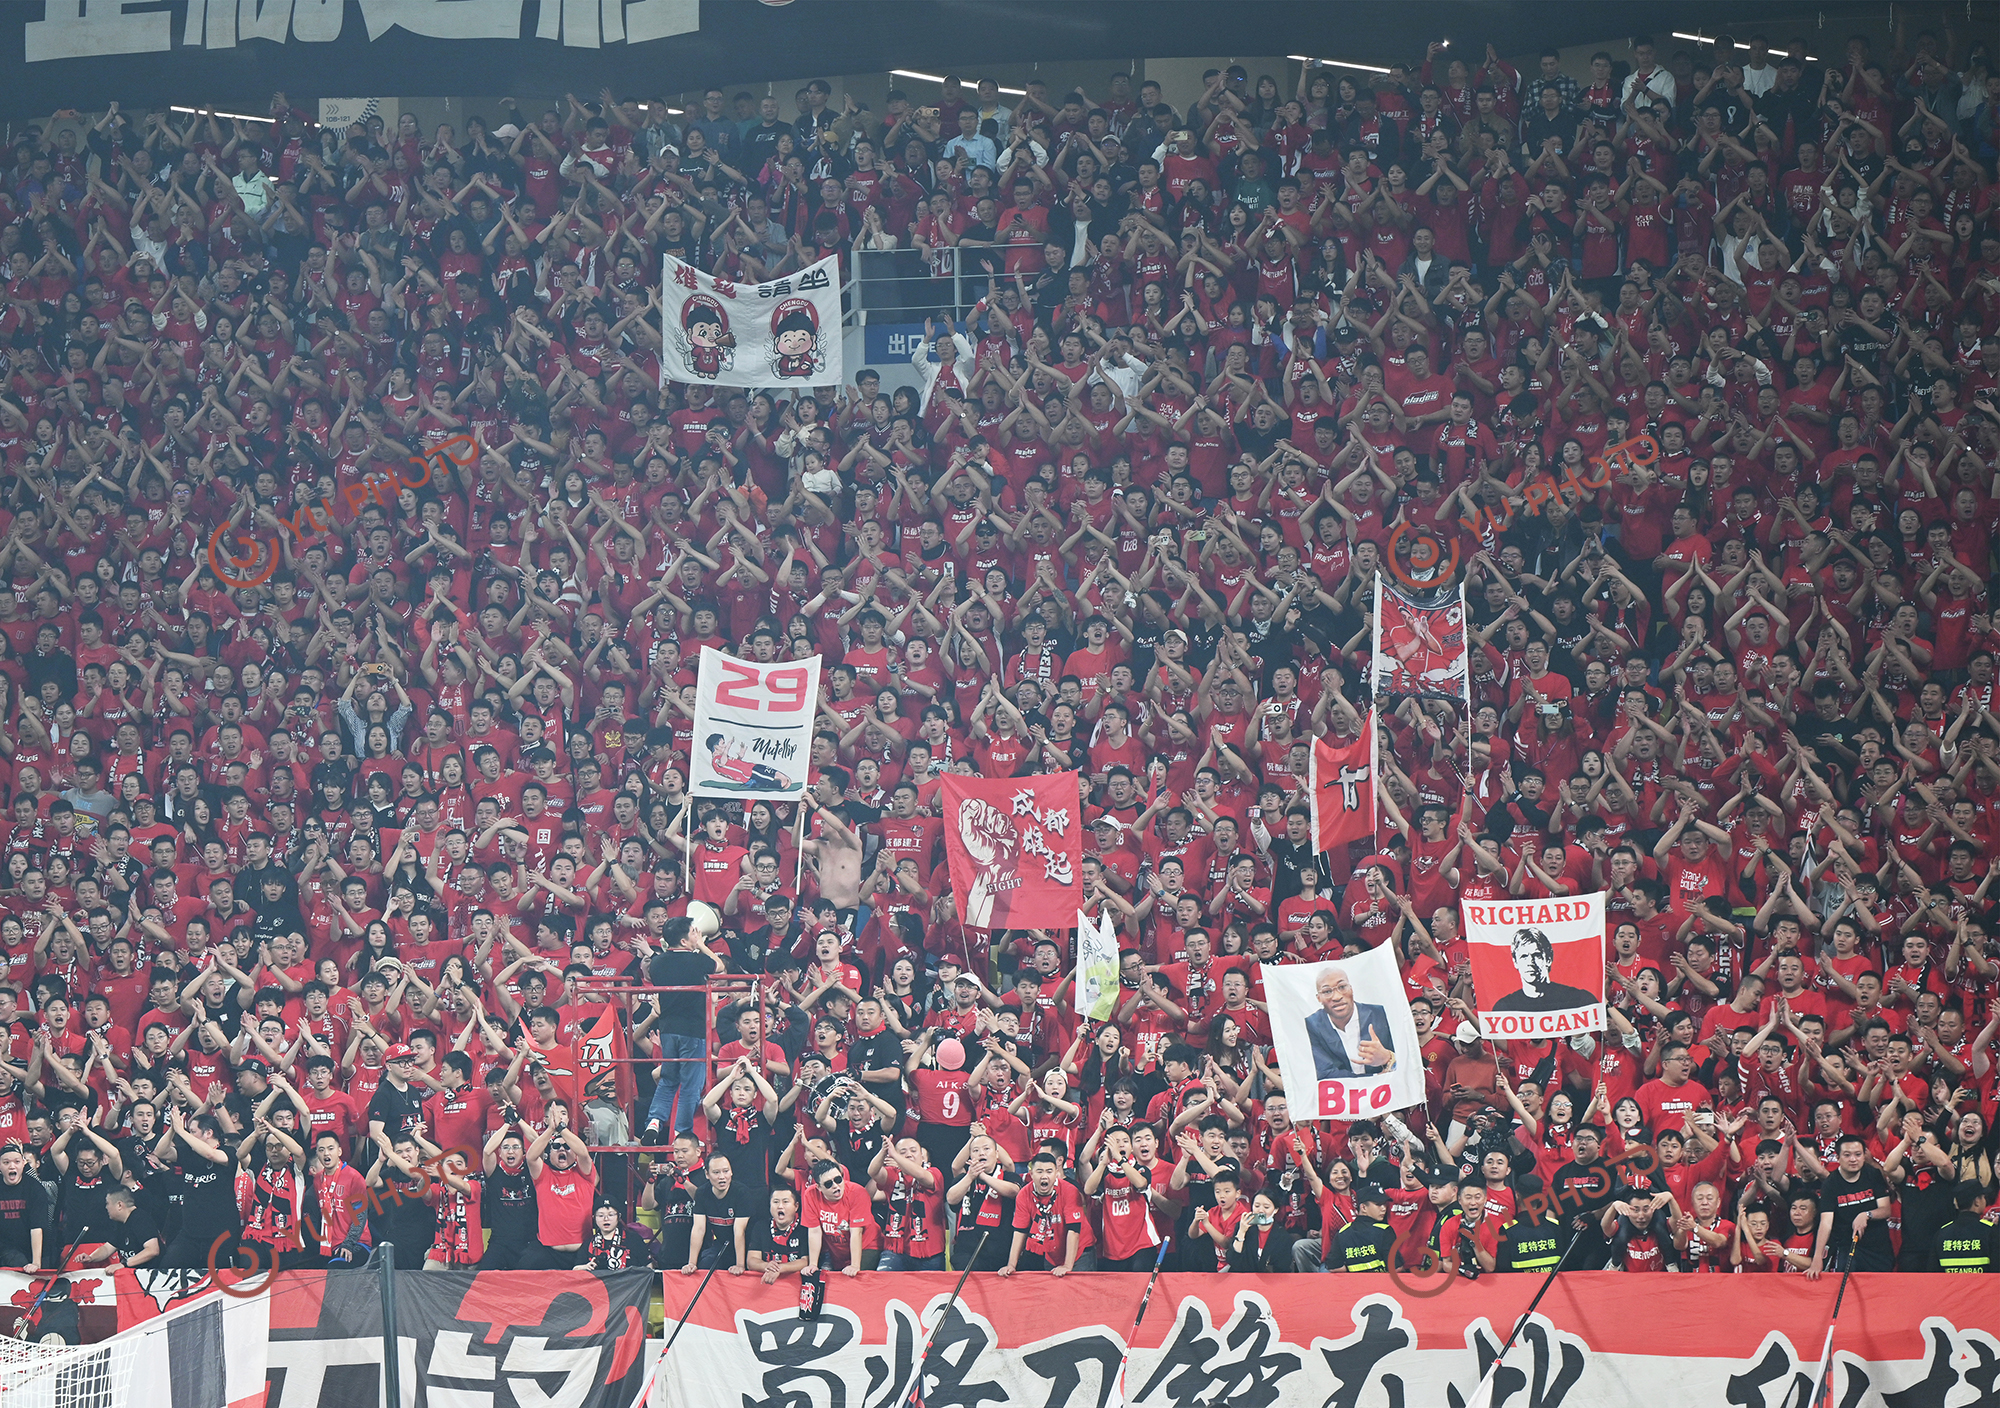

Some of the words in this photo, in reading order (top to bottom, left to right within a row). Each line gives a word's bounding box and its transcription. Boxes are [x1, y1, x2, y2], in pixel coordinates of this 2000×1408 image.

[779, 300, 809, 311] CHENGDU
[888, 333, 924, 355] 出口
[715, 660, 808, 712] 29
[752, 738, 797, 760] Mutellip
[987, 878, 1023, 893] FIGHT
[1469, 901, 1590, 925] RICHARD
[1484, 1016, 1535, 1034] YOU
[1540, 1008, 1599, 1033] CAN!
[942, 1091, 960, 1119] 9
[1318, 1080, 1392, 1116] Bro
[1112, 1199, 1130, 1216] 028
[1345, 1244, 1377, 1259] 捷特安保
[1518, 1239, 1557, 1253] 捷特安保
[1942, 1240, 1981, 1252] 捷特安保
